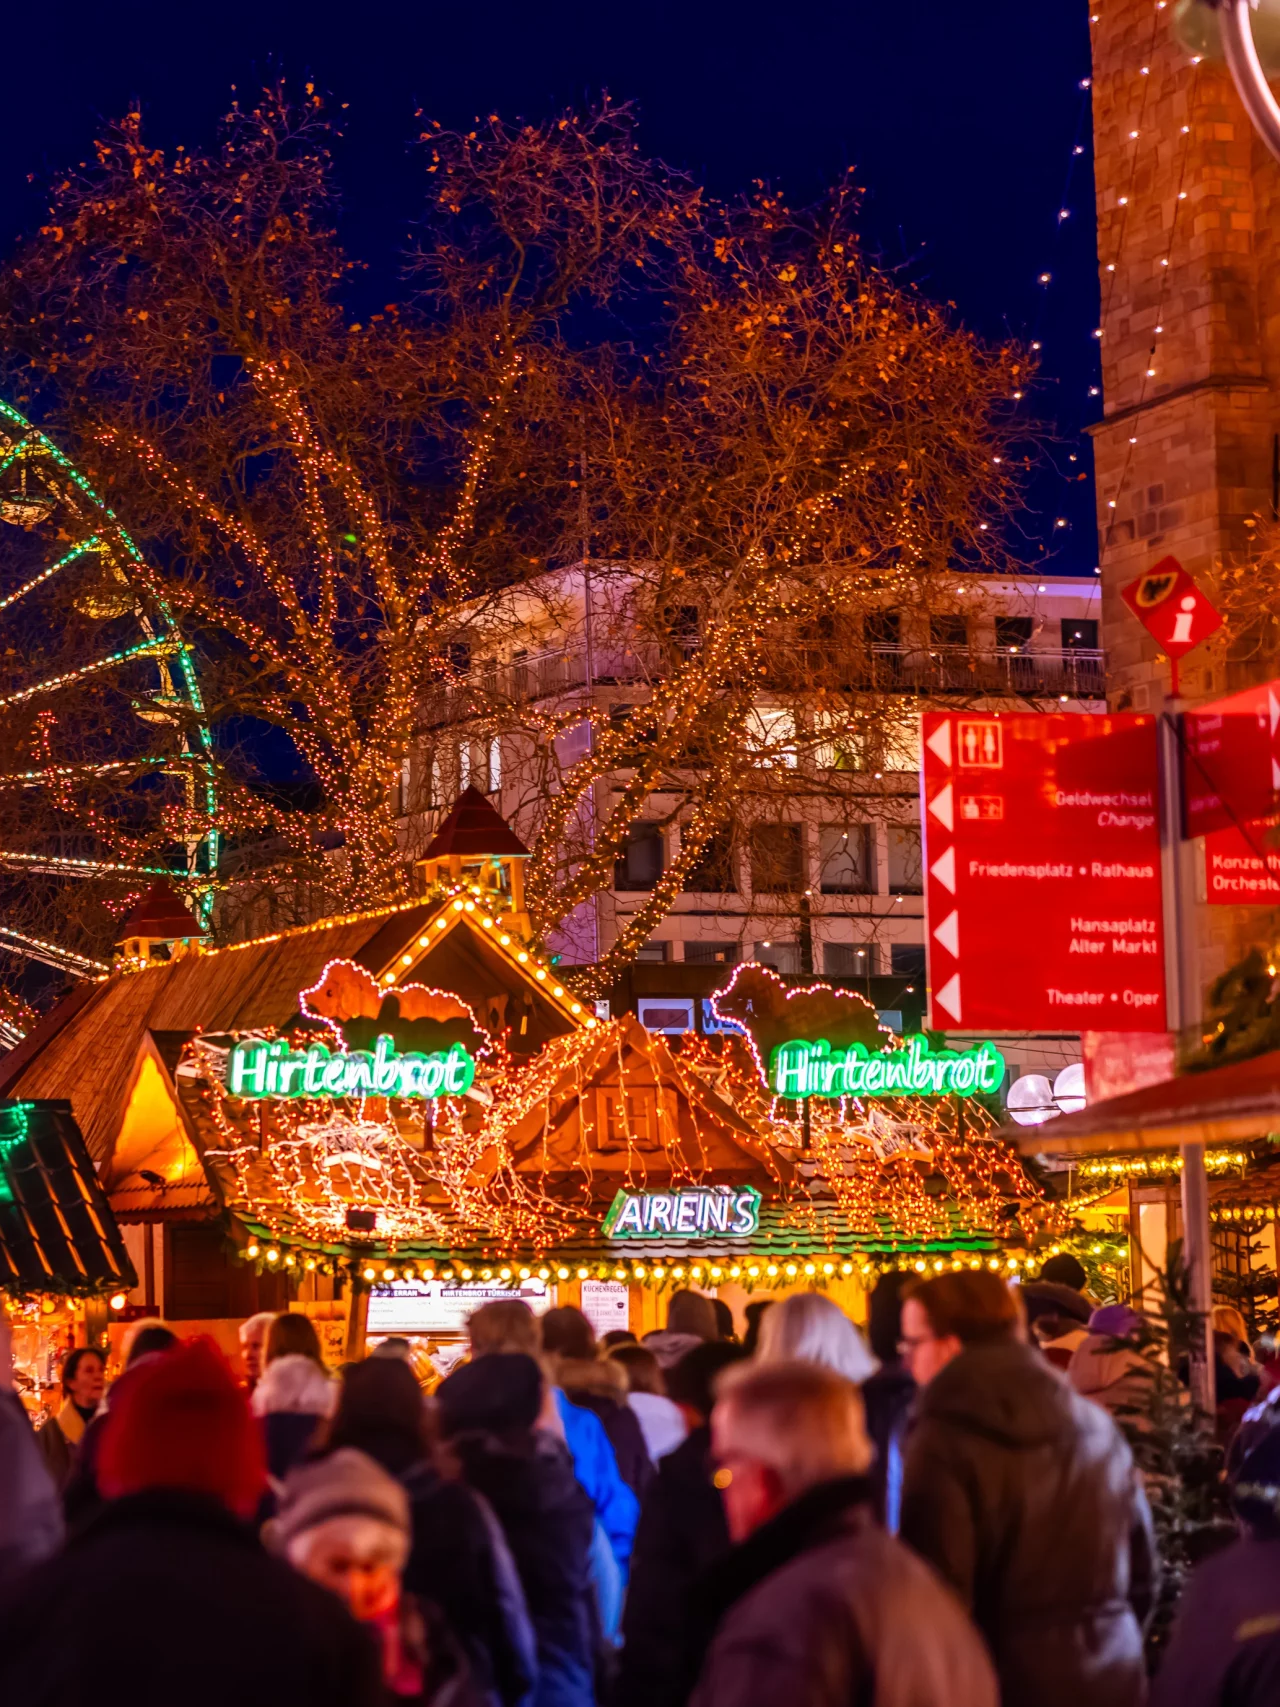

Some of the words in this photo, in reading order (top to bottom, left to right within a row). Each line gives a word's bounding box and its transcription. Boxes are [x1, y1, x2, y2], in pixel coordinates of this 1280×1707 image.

[1055, 790, 1152, 807] Geldwechsel
[1097, 811, 1155, 830] Change
[969, 860, 1073, 880] Friedensplatz
[1091, 862, 1154, 878] Rathaus
[1070, 918, 1156, 937] Hansaplatz
[1069, 938, 1105, 954] Alter
[1113, 938, 1157, 954] Markt
[1047, 989, 1105, 1005] Theater
[1123, 989, 1159, 1008] Oper
[232, 1036, 467, 1094] Hirtenbrot
[776, 1040, 998, 1093] Hirtenbrot
[442, 1289, 486, 1297] HIRTENBROT
[488, 1288, 521, 1297] TÜRKISCH
[583, 1285, 628, 1293] KÜCHENREGELN
